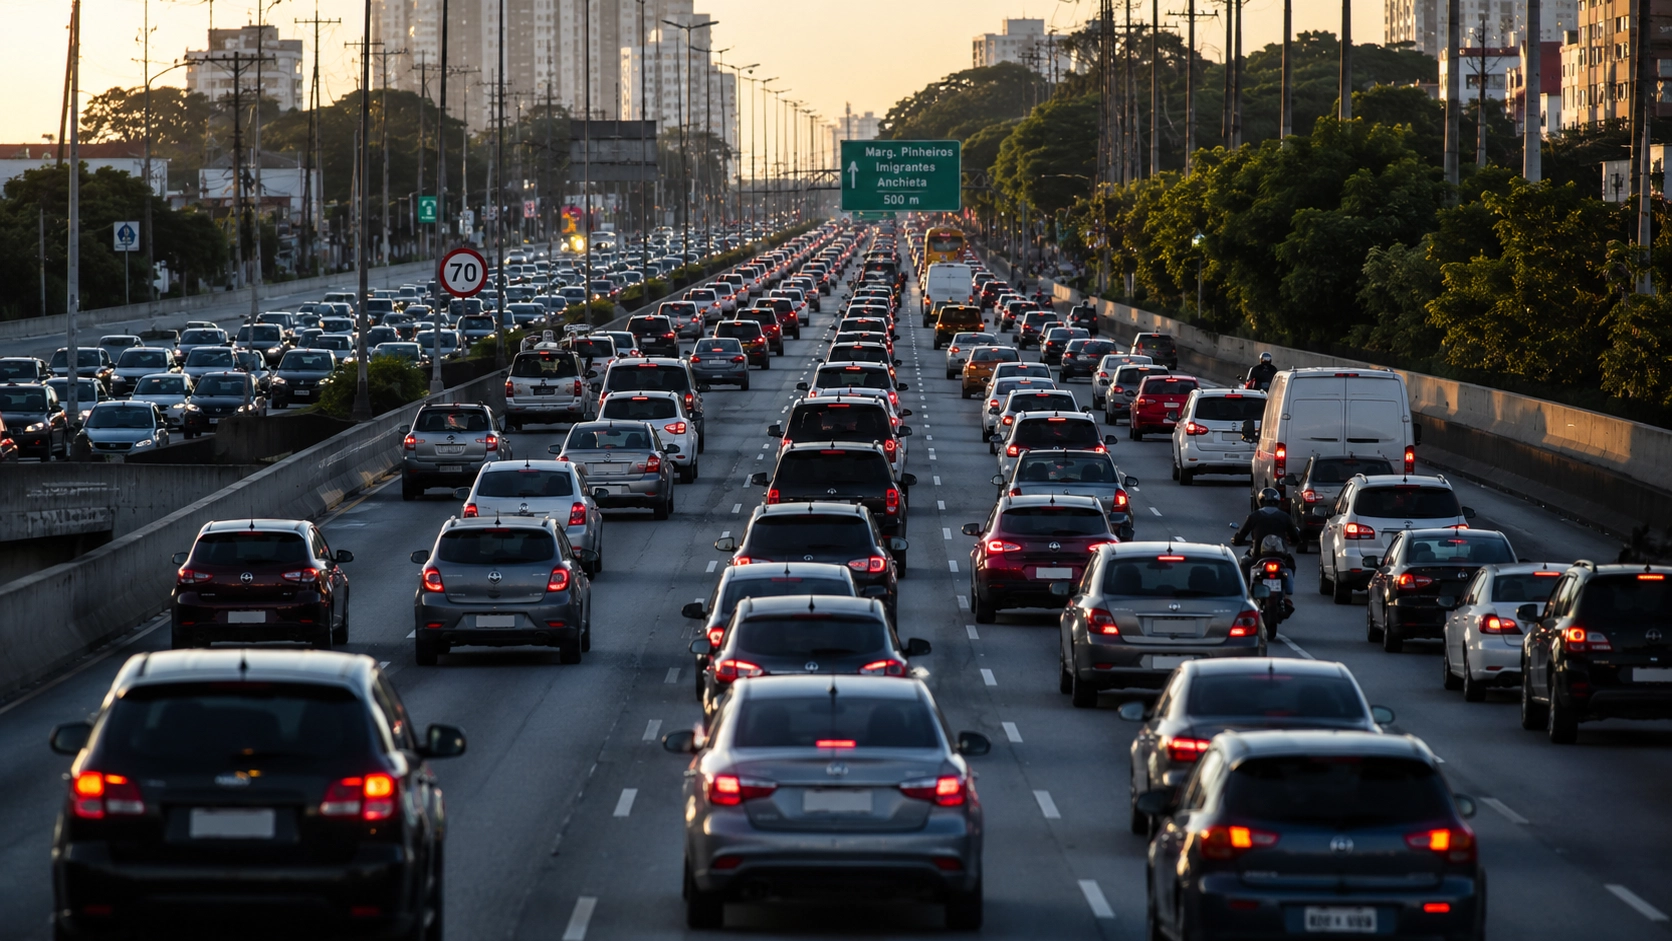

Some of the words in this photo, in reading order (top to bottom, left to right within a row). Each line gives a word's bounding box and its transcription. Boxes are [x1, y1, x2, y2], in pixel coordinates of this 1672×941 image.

[865, 147, 896, 159] Marg.
[901, 147, 953, 157] Pinheiros
[876, 161, 935, 174] Imigrantes
[877, 177, 927, 187] Anchieta
[884, 194, 904, 204] 500
[909, 196, 919, 204] m
[450, 263, 476, 282] 70
